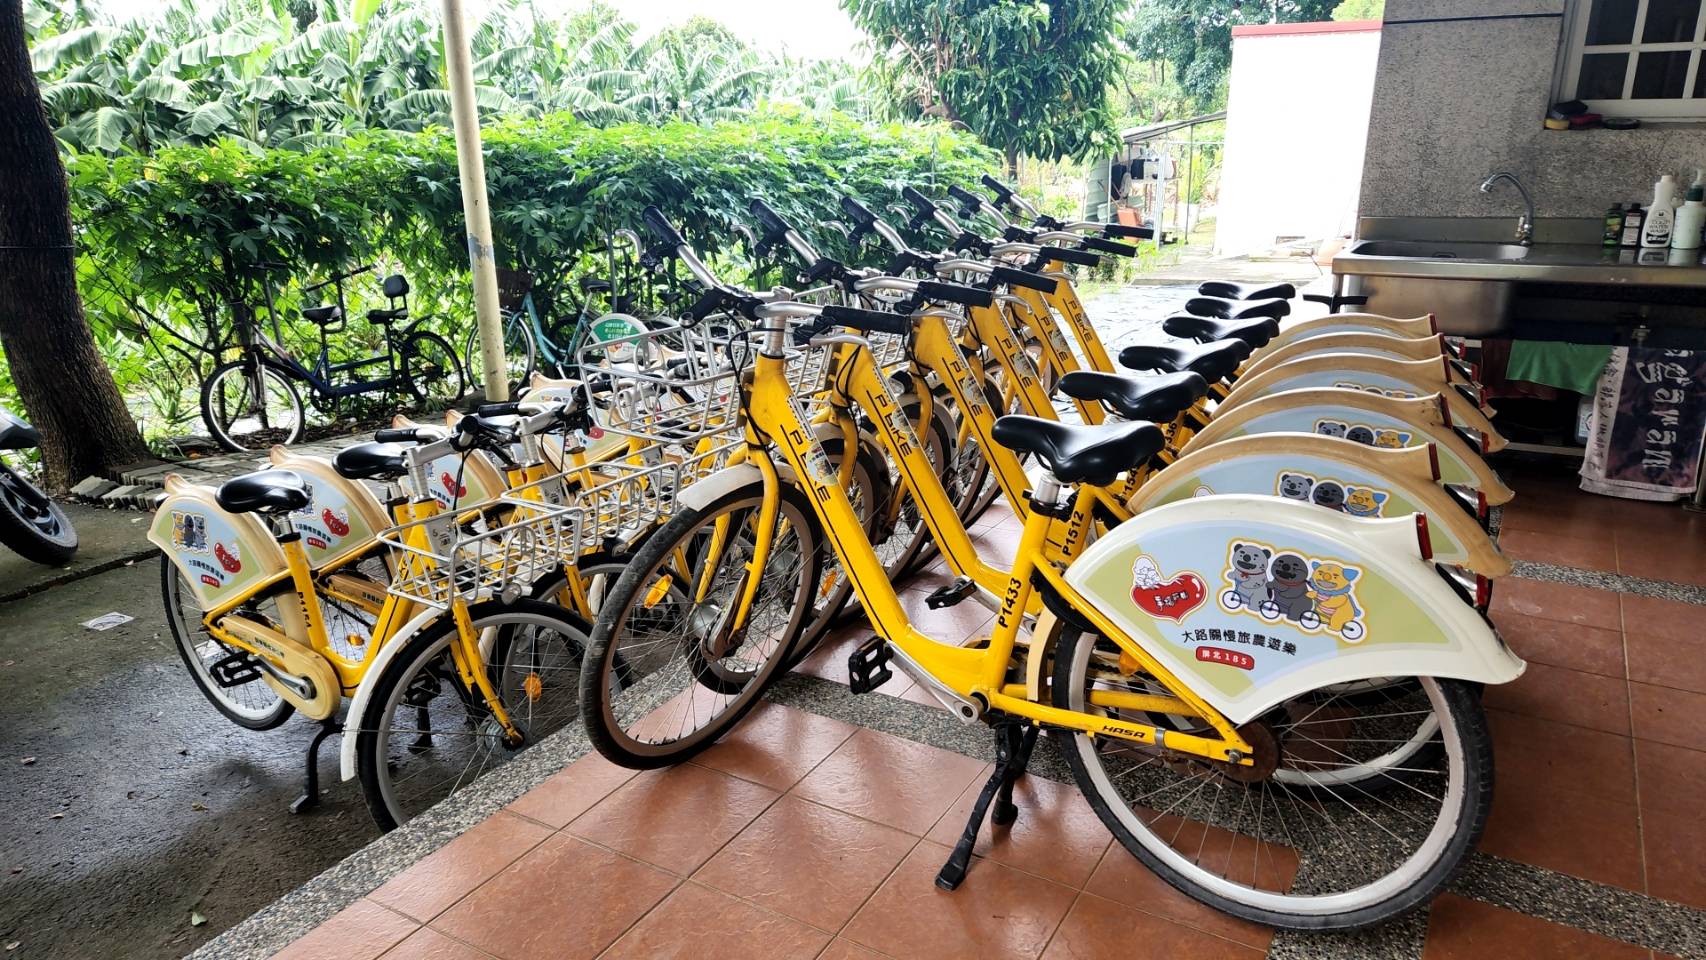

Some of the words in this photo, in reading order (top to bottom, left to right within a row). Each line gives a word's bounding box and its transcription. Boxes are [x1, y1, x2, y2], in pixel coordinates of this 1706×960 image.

[1165, 422, 1178, 444] 336
[1062, 510, 1085, 556] P1512
[998, 577, 1022, 628] P1433
[1181, 628, 1297, 656] 大路關慢旅農遊樂
[1102, 725, 1146, 738] HASA
